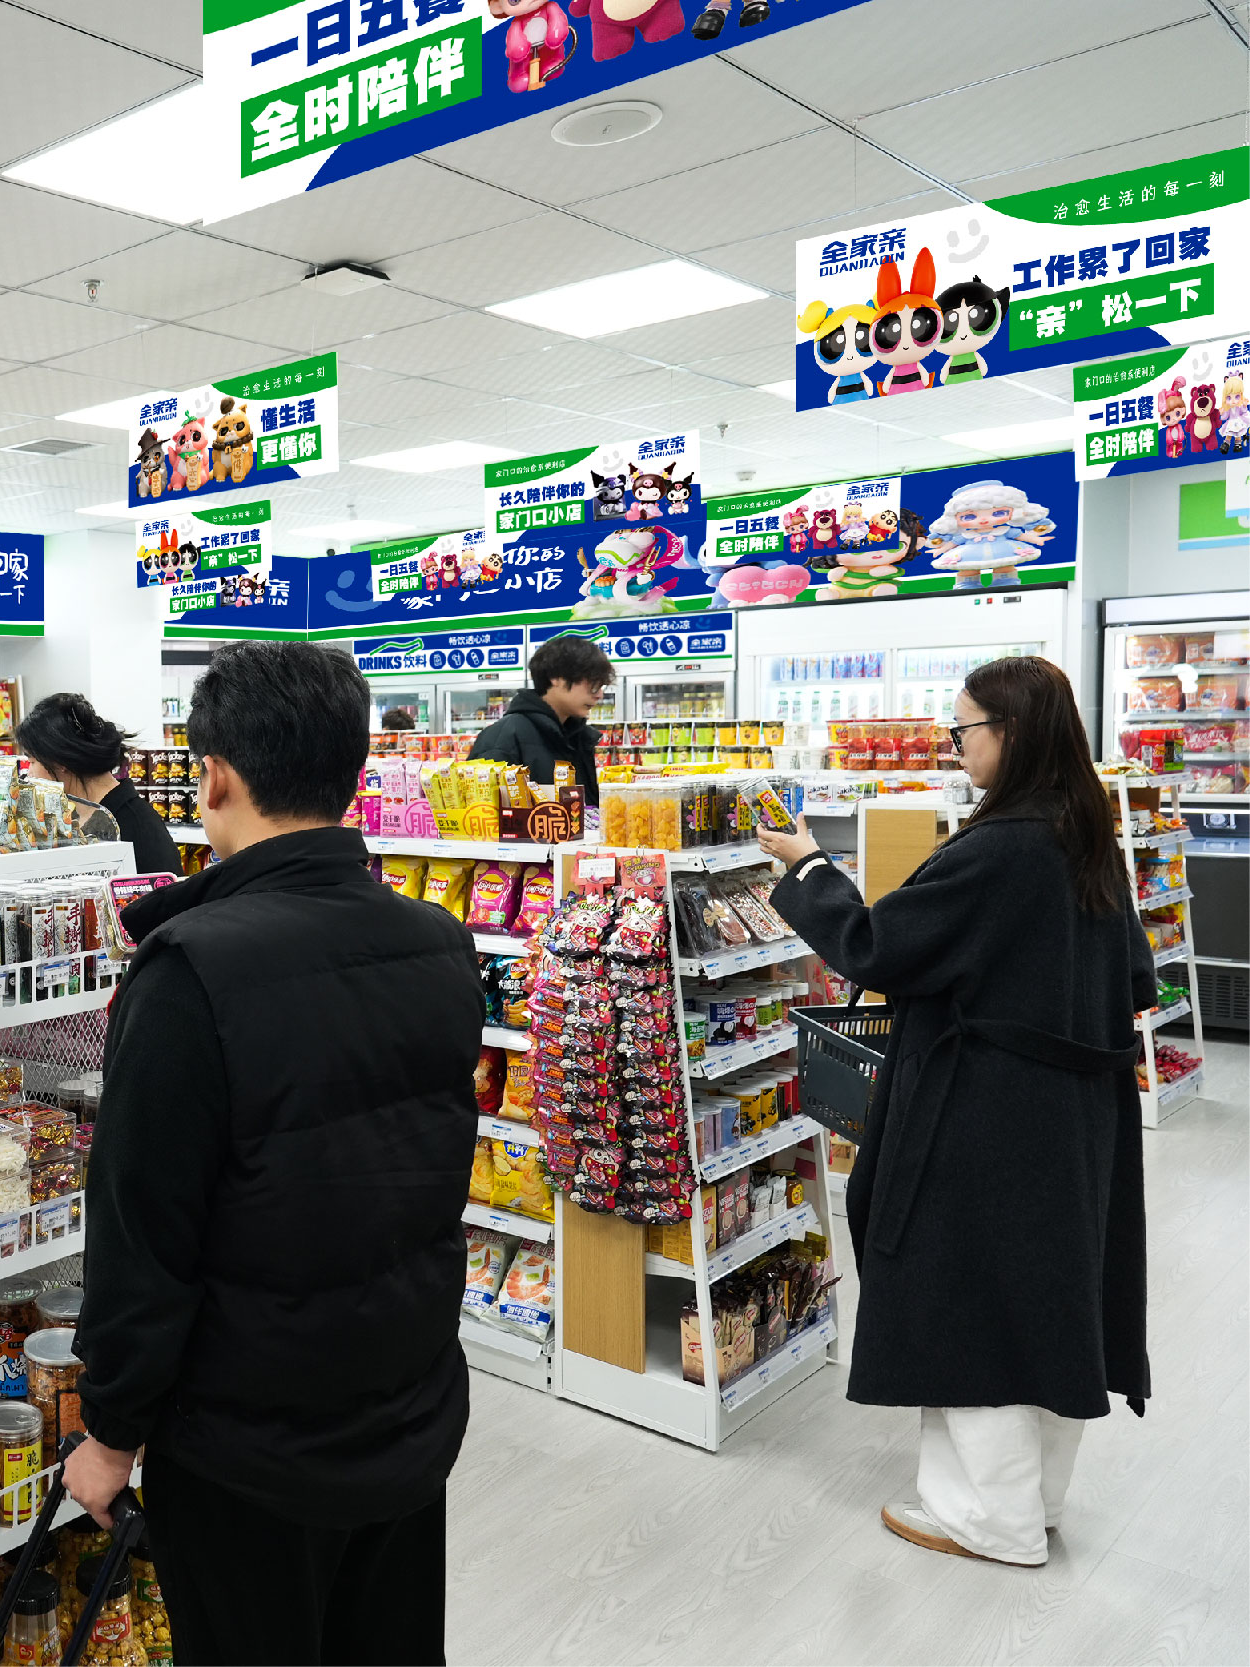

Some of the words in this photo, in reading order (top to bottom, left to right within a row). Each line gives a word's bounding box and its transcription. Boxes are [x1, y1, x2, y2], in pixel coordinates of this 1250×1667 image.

[250, 37, 465, 163] 全时陪伴
[1053, 170, 1225, 220] 治愈生活的每一刻
[820, 227, 907, 266] 全家亲
[1011, 226, 1211, 292] 工作累了回家
[140, 398, 178, 419] 全家亲
[261, 398, 316, 432] 懂生活
[1089, 396, 1154, 426] 一日五餐
[261, 431, 317, 464] 更懂你
[638, 435, 686, 456] 全家亲
[1089, 428, 1155, 460] 全时陪伴
[499, 481, 585, 508] 长久陪伴你的
[846, 482, 889, 497] 全家亲
[499, 503, 582, 531] 家门口小店
[719, 516, 780, 535] 一日五餐
[200, 529, 260, 549] 工作累了回家
[719, 535, 780, 555] 全时陪伴
[380, 560, 419, 577] 一日五餐
[171, 581, 217, 596] 长久陪伴你的
[380, 576, 420, 593] 全时陪伴
[171, 595, 215, 612] 家门口小店
[639, 620, 690, 633] 畅饮透心凉
[448, 634, 491, 646] 畅饮透心凉
[358, 655, 402, 671] DRINKS
[403, 654, 427, 668] 饮料
[534, 805, 567, 844] 脆
